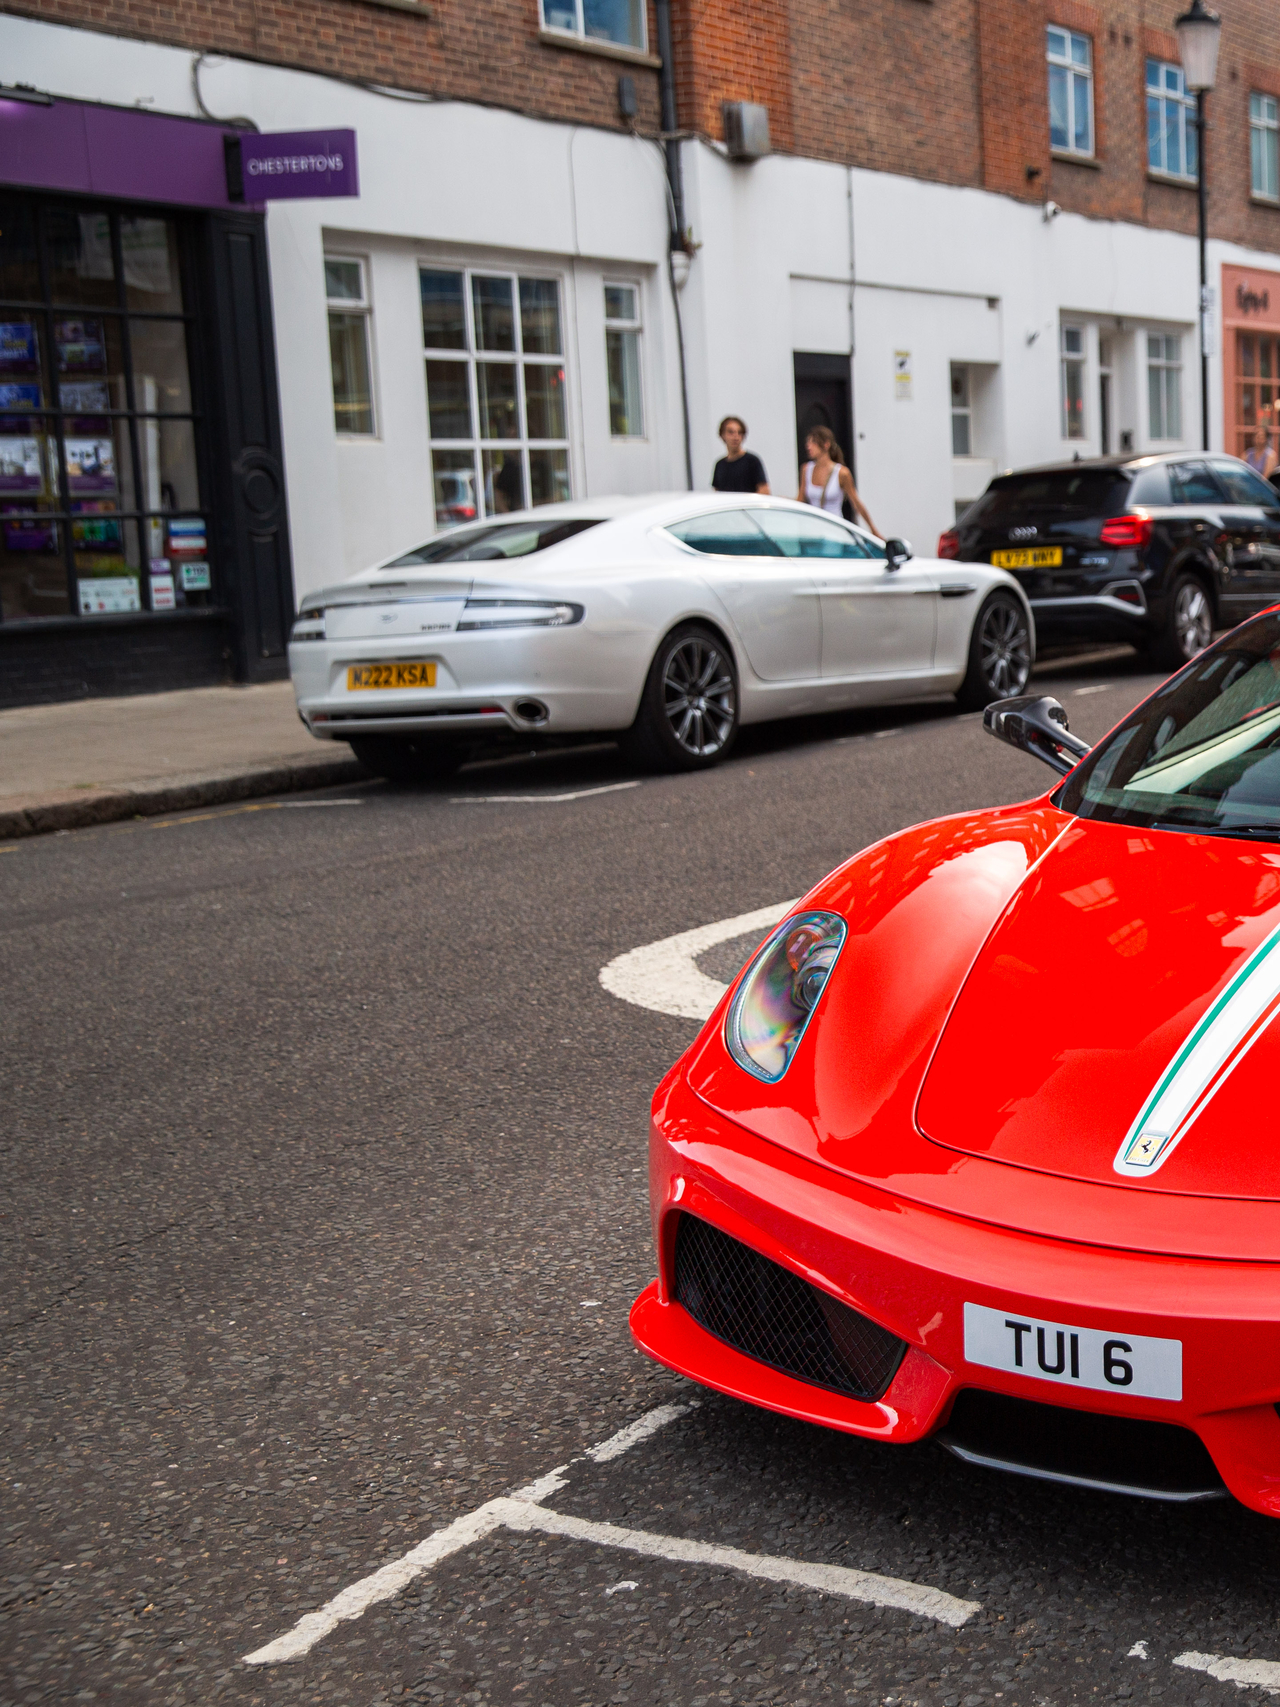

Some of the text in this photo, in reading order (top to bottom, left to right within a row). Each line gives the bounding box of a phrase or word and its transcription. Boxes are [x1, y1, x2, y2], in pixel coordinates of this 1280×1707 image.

[247, 153, 344, 176] CHESTERTONS
[353, 663, 429, 687] N222 KSA
[1005, 1319, 1133, 1386] TUI 6
